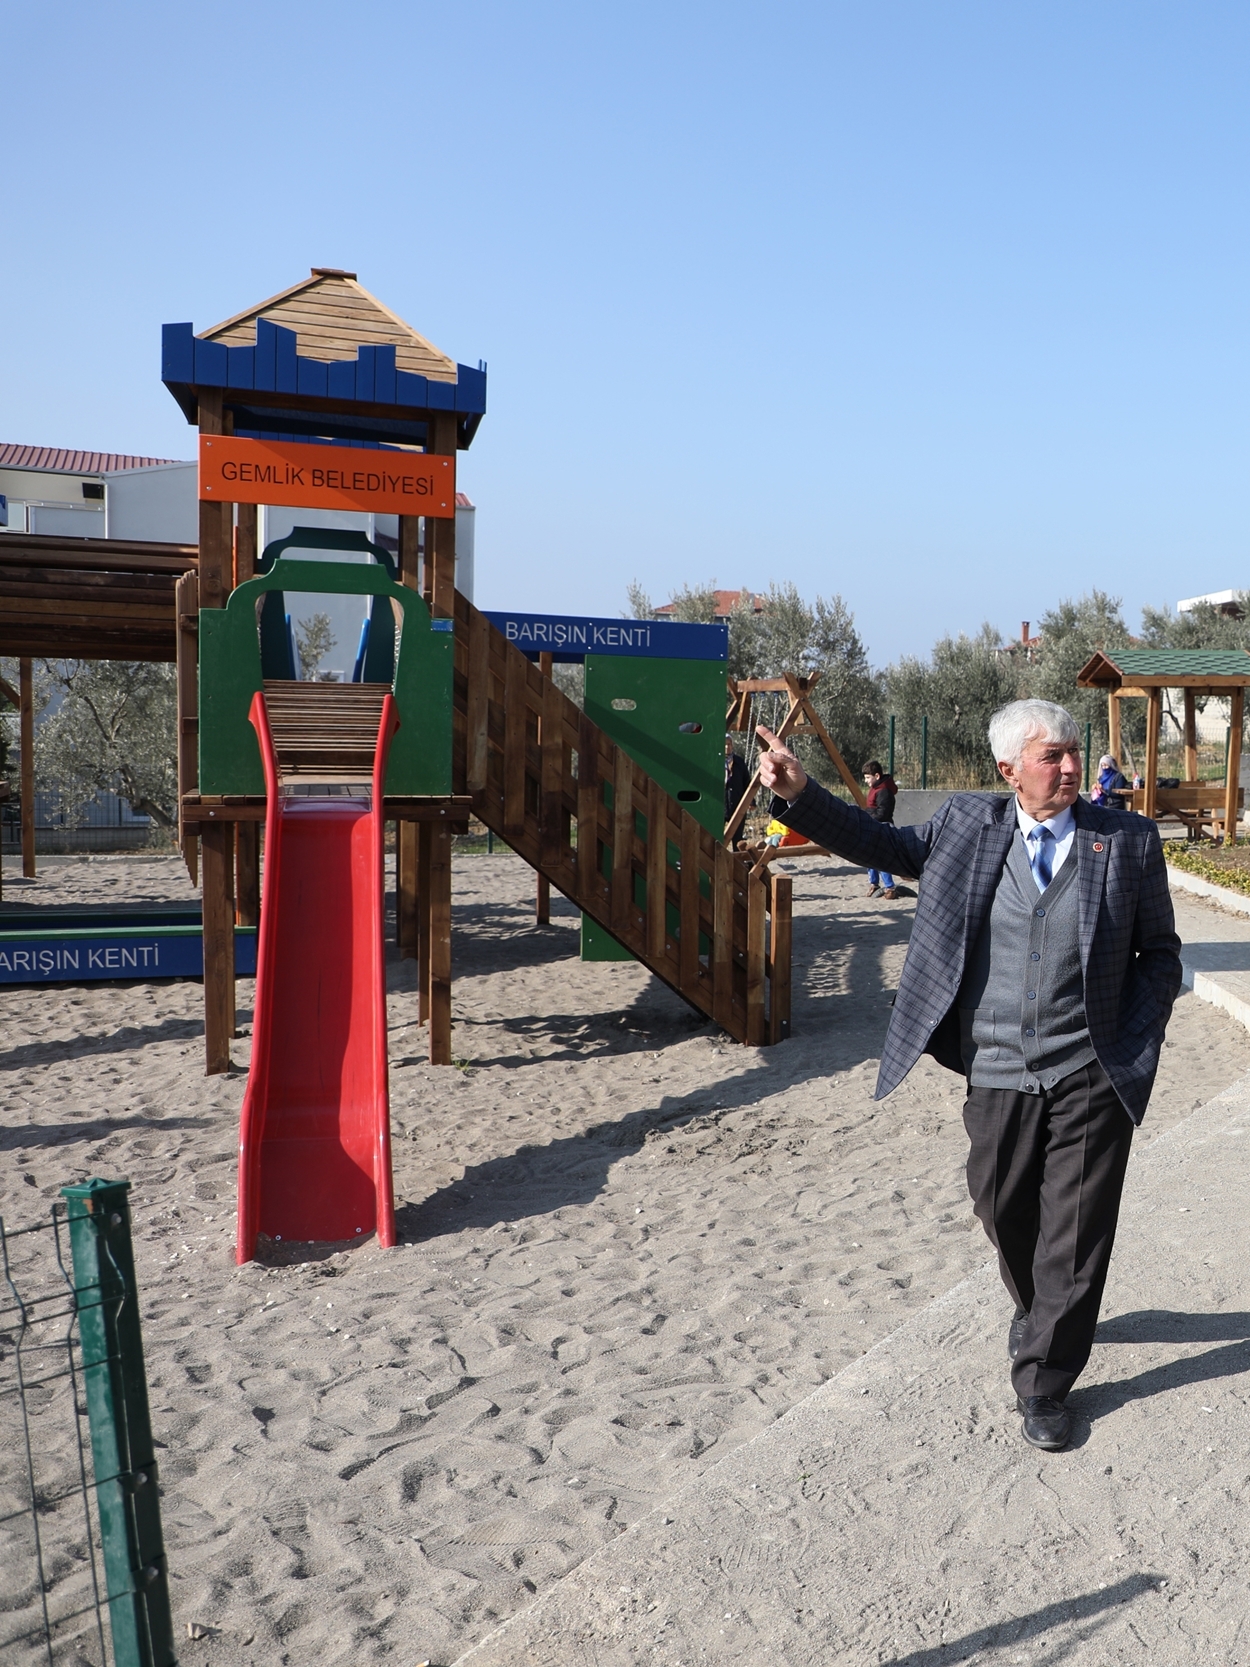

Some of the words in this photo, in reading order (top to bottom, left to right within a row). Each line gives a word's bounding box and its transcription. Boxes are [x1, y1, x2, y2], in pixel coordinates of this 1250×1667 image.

[221, 461, 305, 486] GEMLİK
[311, 468, 434, 496] BELEDİYESİ
[505, 621, 587, 647] BARIŞIN
[593, 626, 650, 647] KENTİ
[88, 943, 159, 969] KENTİ
